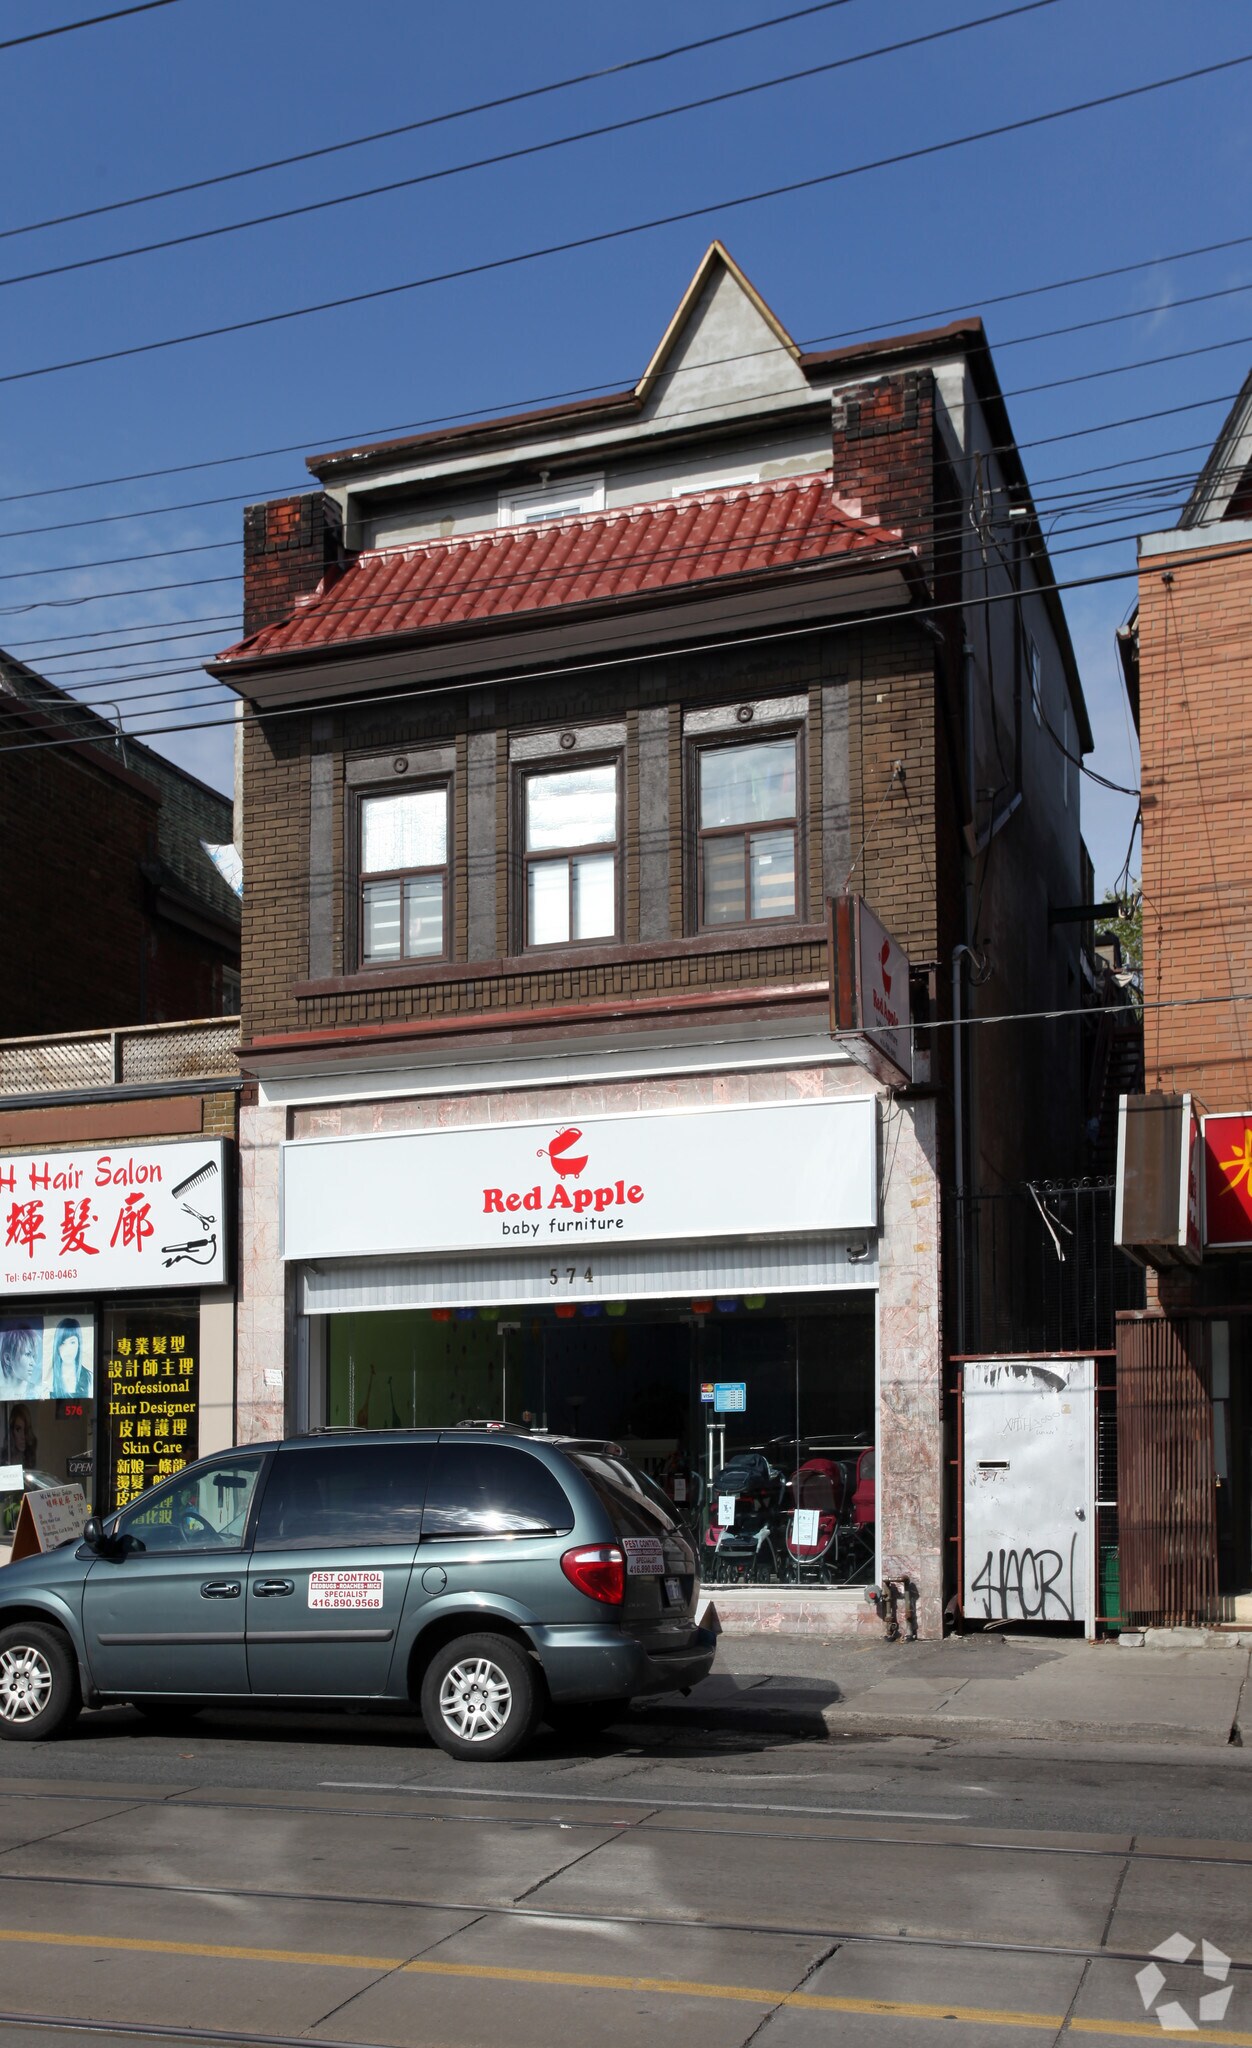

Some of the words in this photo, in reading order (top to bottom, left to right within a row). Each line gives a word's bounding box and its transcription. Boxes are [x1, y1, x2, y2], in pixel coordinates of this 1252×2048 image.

[29, 1161, 83, 1191] Hair
[95, 1156, 162, 1187] Salon
[482, 1186, 542, 1213] Red
[547, 1180, 644, 1213] Apple
[502, 1220, 540, 1237] baby
[549, 1217, 624, 1233] furniture
[5, 1273, 20, 1283] Tel:
[22, 1269, 78, 1282] 647-708-0463
[549, 1266, 593, 1285] 574
[117, 1335, 185, 1356] 專業髮型
[108, 1358, 194, 1378] 設計師主理
[113, 1379, 190, 1395] Professional
[65, 1405, 83, 1416] 576
[109, 1402, 137, 1415] Hair
[139, 1401, 196, 1417] Designer
[119, 1419, 187, 1438] 皮膚護理
[122, 1441, 150, 1455] Skin
[153, 1440, 182, 1453] Care
[69, 1462, 93, 1473] OPEN
[624, 1540, 639, 1548] PEST
[639, 1539, 661, 1548] CONTROL
[311, 1573, 335, 1582] PEST
[337, 1573, 382, 1582] CONTROL
[324, 1590, 368, 1598] SPECIALIST
[312, 1599, 380, 1608] 416.890.9568
